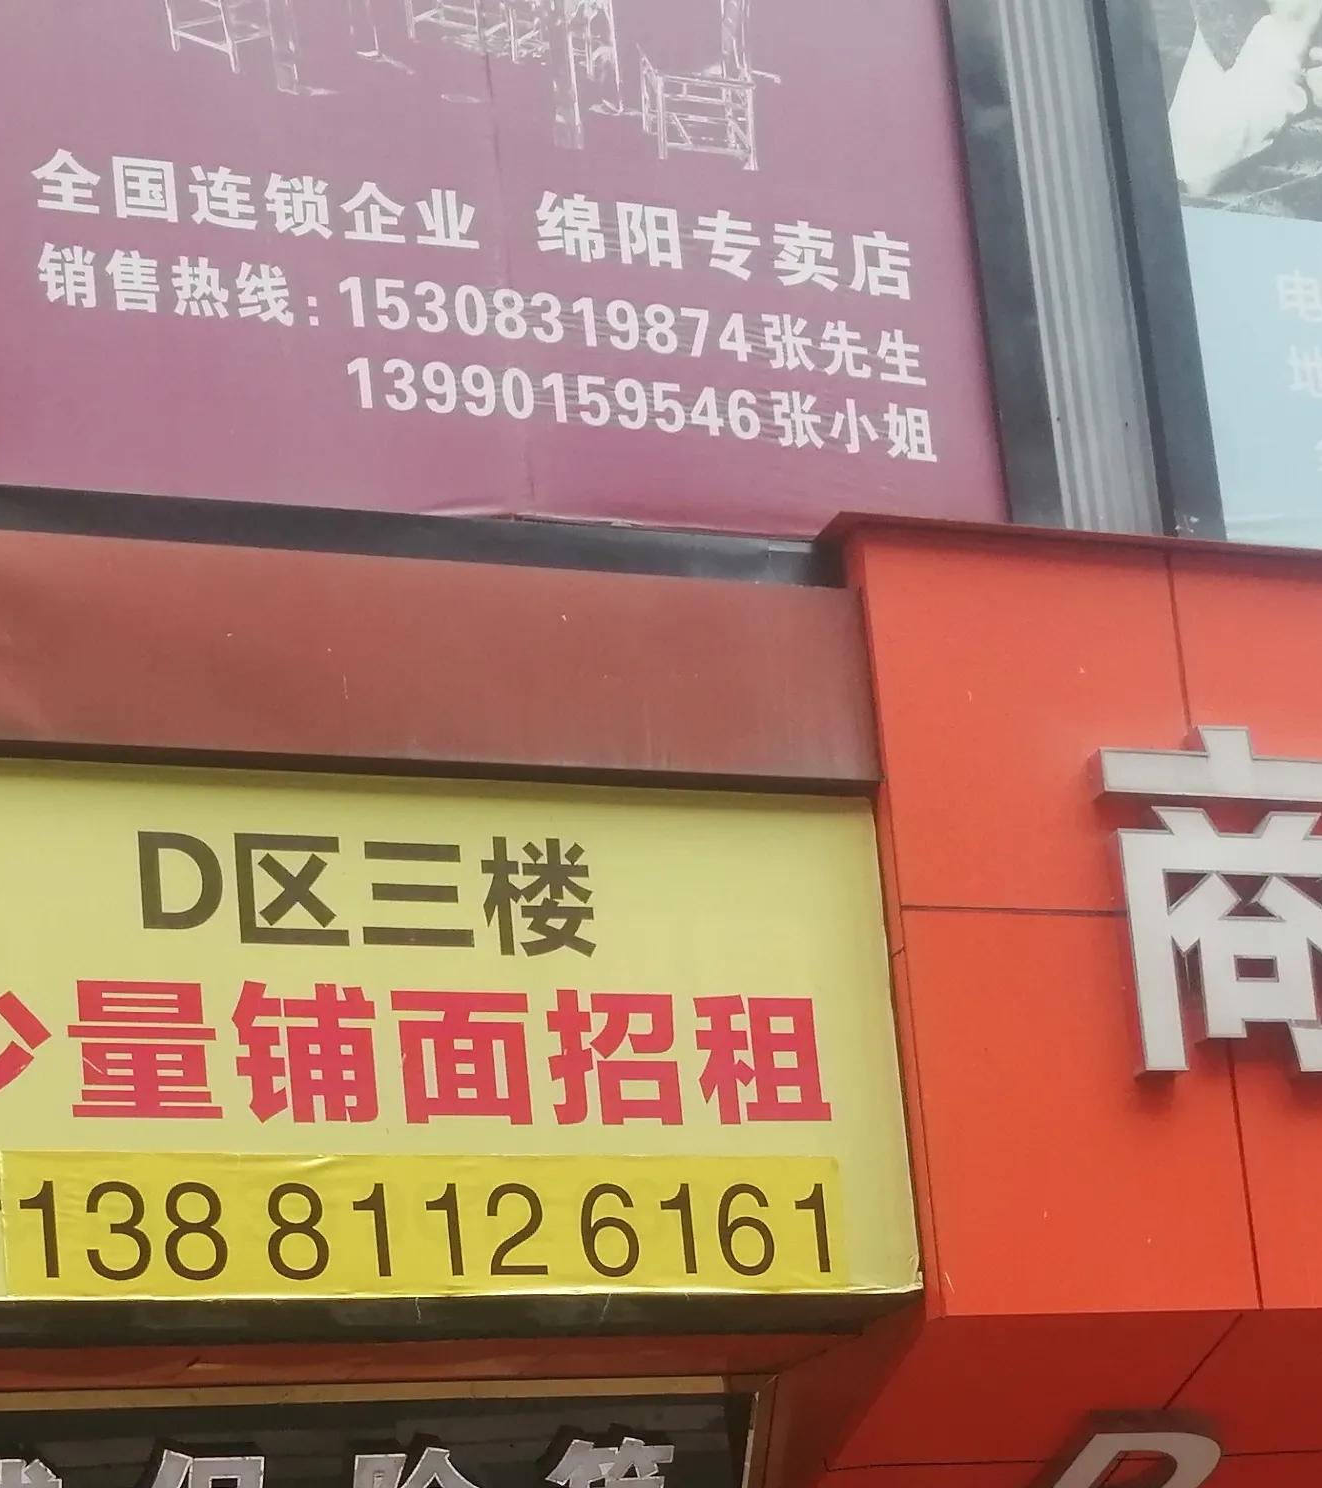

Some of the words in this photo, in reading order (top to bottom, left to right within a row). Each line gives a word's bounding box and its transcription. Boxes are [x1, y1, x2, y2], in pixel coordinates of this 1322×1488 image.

[31, 148, 480, 252] 全国连锁企业
[535, 191, 913, 301] 绵阳专卖店
[345, 358, 937, 463] 13990159546张小姐
[136, 829, 598, 960] D区三楼
[17, 1178, 231, 1281] 138
[265, 1180, 551, 1279] 8112
[578, 1180, 835, 1277] 6161
